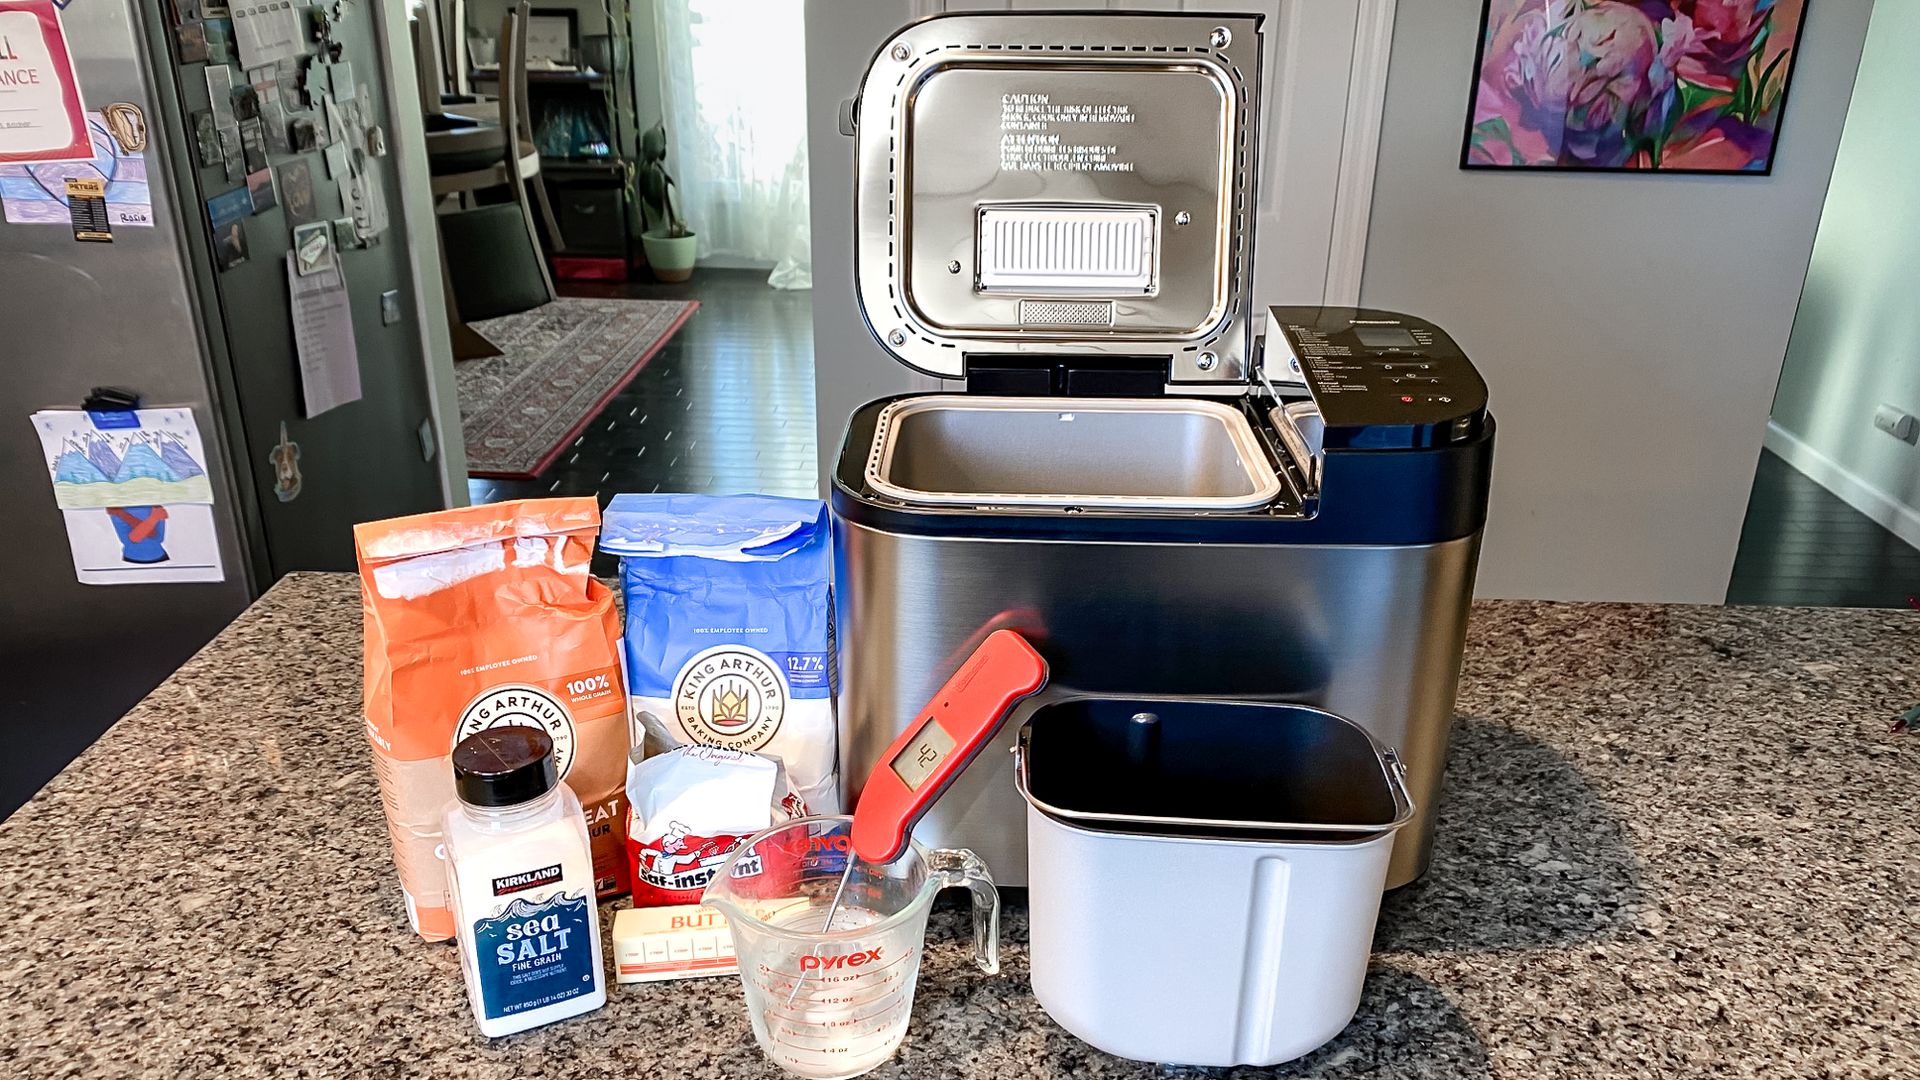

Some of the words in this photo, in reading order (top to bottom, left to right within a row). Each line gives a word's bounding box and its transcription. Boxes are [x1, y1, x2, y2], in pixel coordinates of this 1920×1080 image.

[68, 183, 99, 191] PETERS
[475, 659, 511, 673] EMPLOYEE
[511, 654, 538, 666] OWNED
[787, 656, 824, 670] 12.7%
[566, 674, 609, 695] 100%
[684, 664, 715, 700] KING
[720, 658, 776, 700] ARTHUR
[571, 693, 593, 703] WHOLE
[495, 696, 562, 730] ARTHUR
[687, 716, 723, 748] BAKING
[727, 716, 773, 749] COMPANY
[917, 743, 937, 768] 42
[495, 867, 560, 889] KIRKLAND
[641, 859, 760, 889] saf-instnt
[506, 914, 560, 941] sea
[497, 928, 571, 966] SALT
[512, 961, 532, 972] FINE
[533, 952, 562, 967] GRAIN
[800, 946, 882, 972] pyrex
[503, 1005, 514, 1013] NET
[514, 1003, 522, 1011] WT
